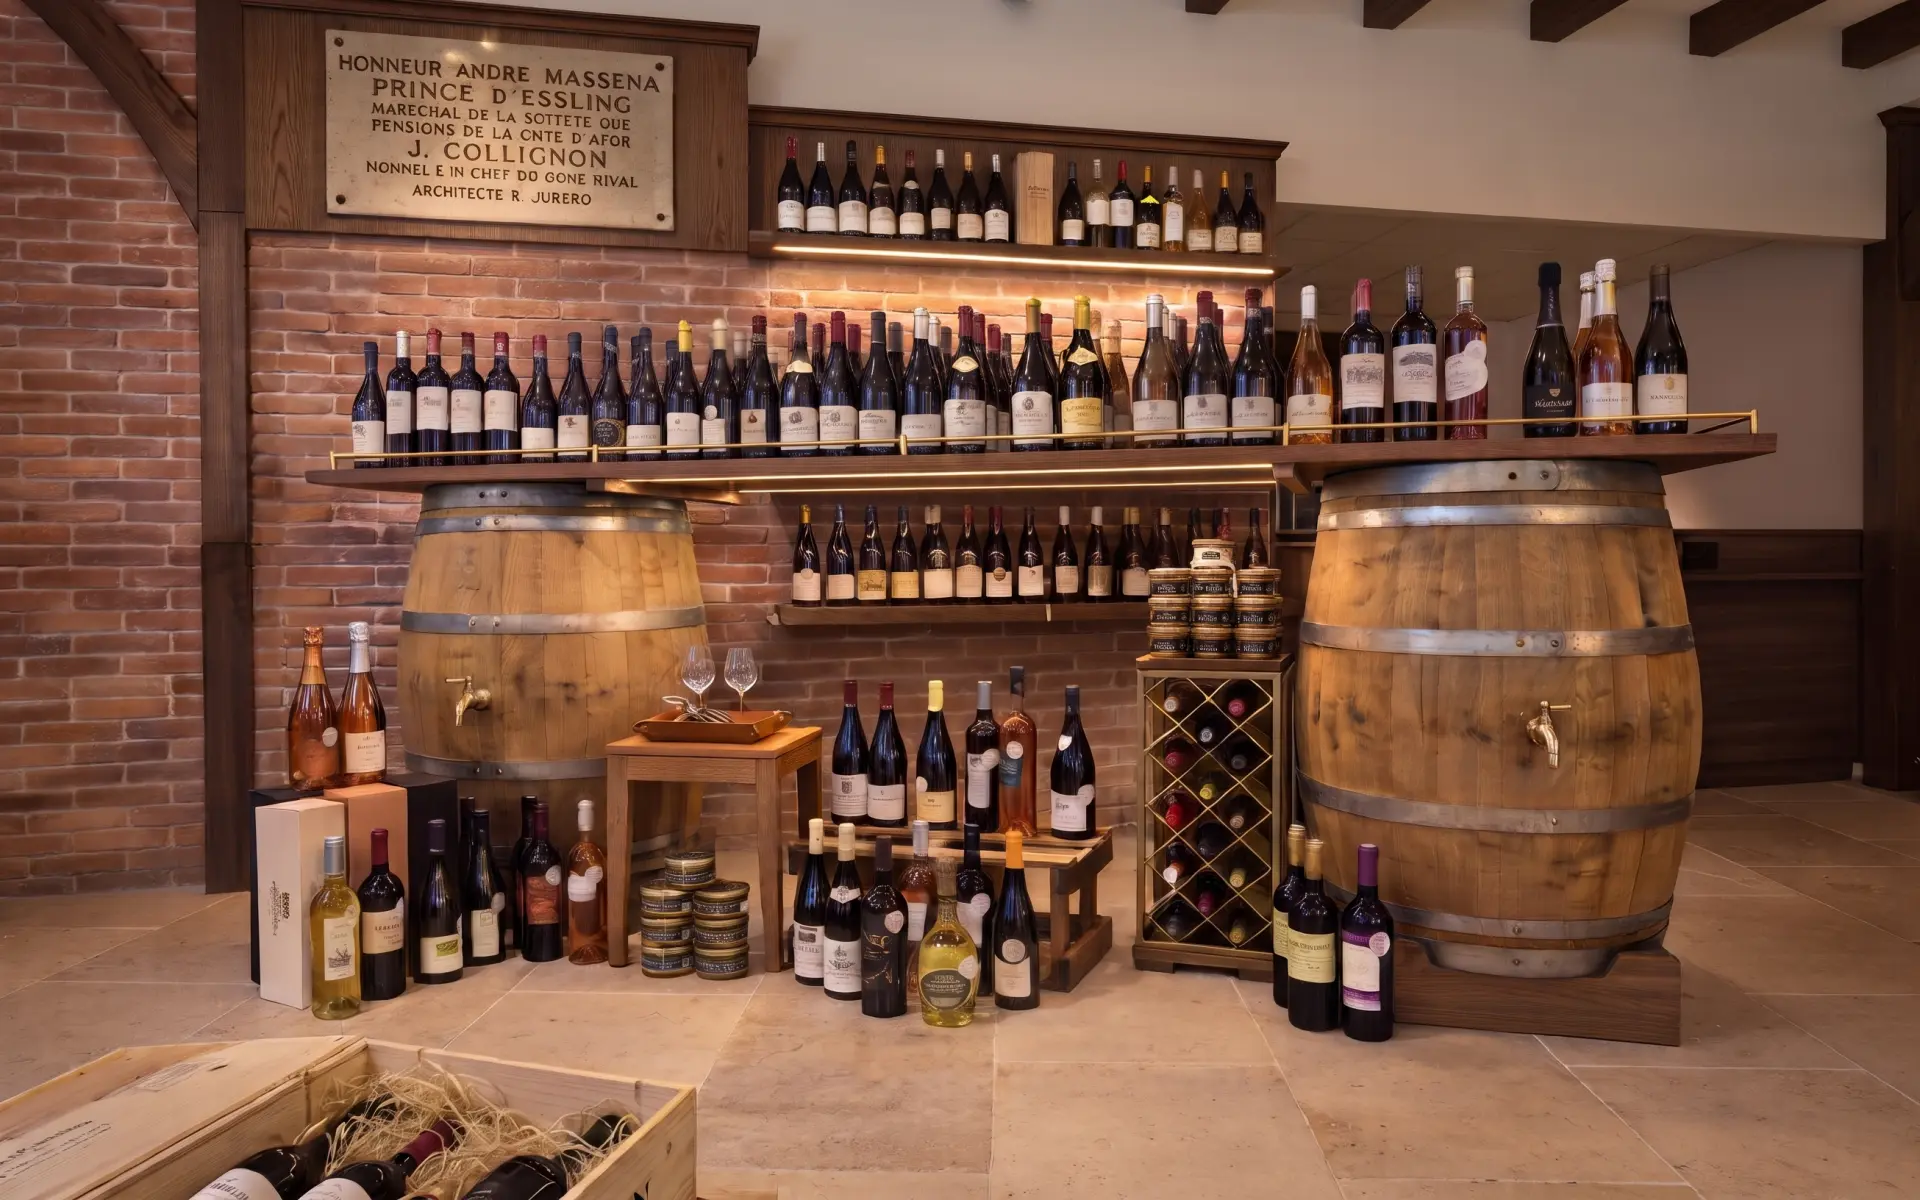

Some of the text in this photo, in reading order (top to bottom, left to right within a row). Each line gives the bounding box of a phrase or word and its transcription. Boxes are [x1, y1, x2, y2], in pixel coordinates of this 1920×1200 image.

[339, 55, 660, 93] HONNEUR ANDRE MASSENA
[372, 78, 474, 102] PRINCE
[371, 102, 461, 120] MARECHAL
[468, 108, 489, 121] DE
[496, 110, 517, 123] LA
[524, 112, 592, 128] SOTTETE
[372, 119, 455, 136] PENSIONS
[463, 125, 484, 138] DE
[493, 127, 513, 140] LA
[520, 129, 563, 144] CNTE
[407, 139, 607, 169] J. COLLIGNON
[450, 166, 464, 178] IN
[470, 167, 510, 180] CHEF
[545, 171, 586, 185] GONE
[593, 174, 639, 188] RIVAL
[412, 184, 503, 201] ARCHITECTE
[531, 191, 592, 206] JURERO
